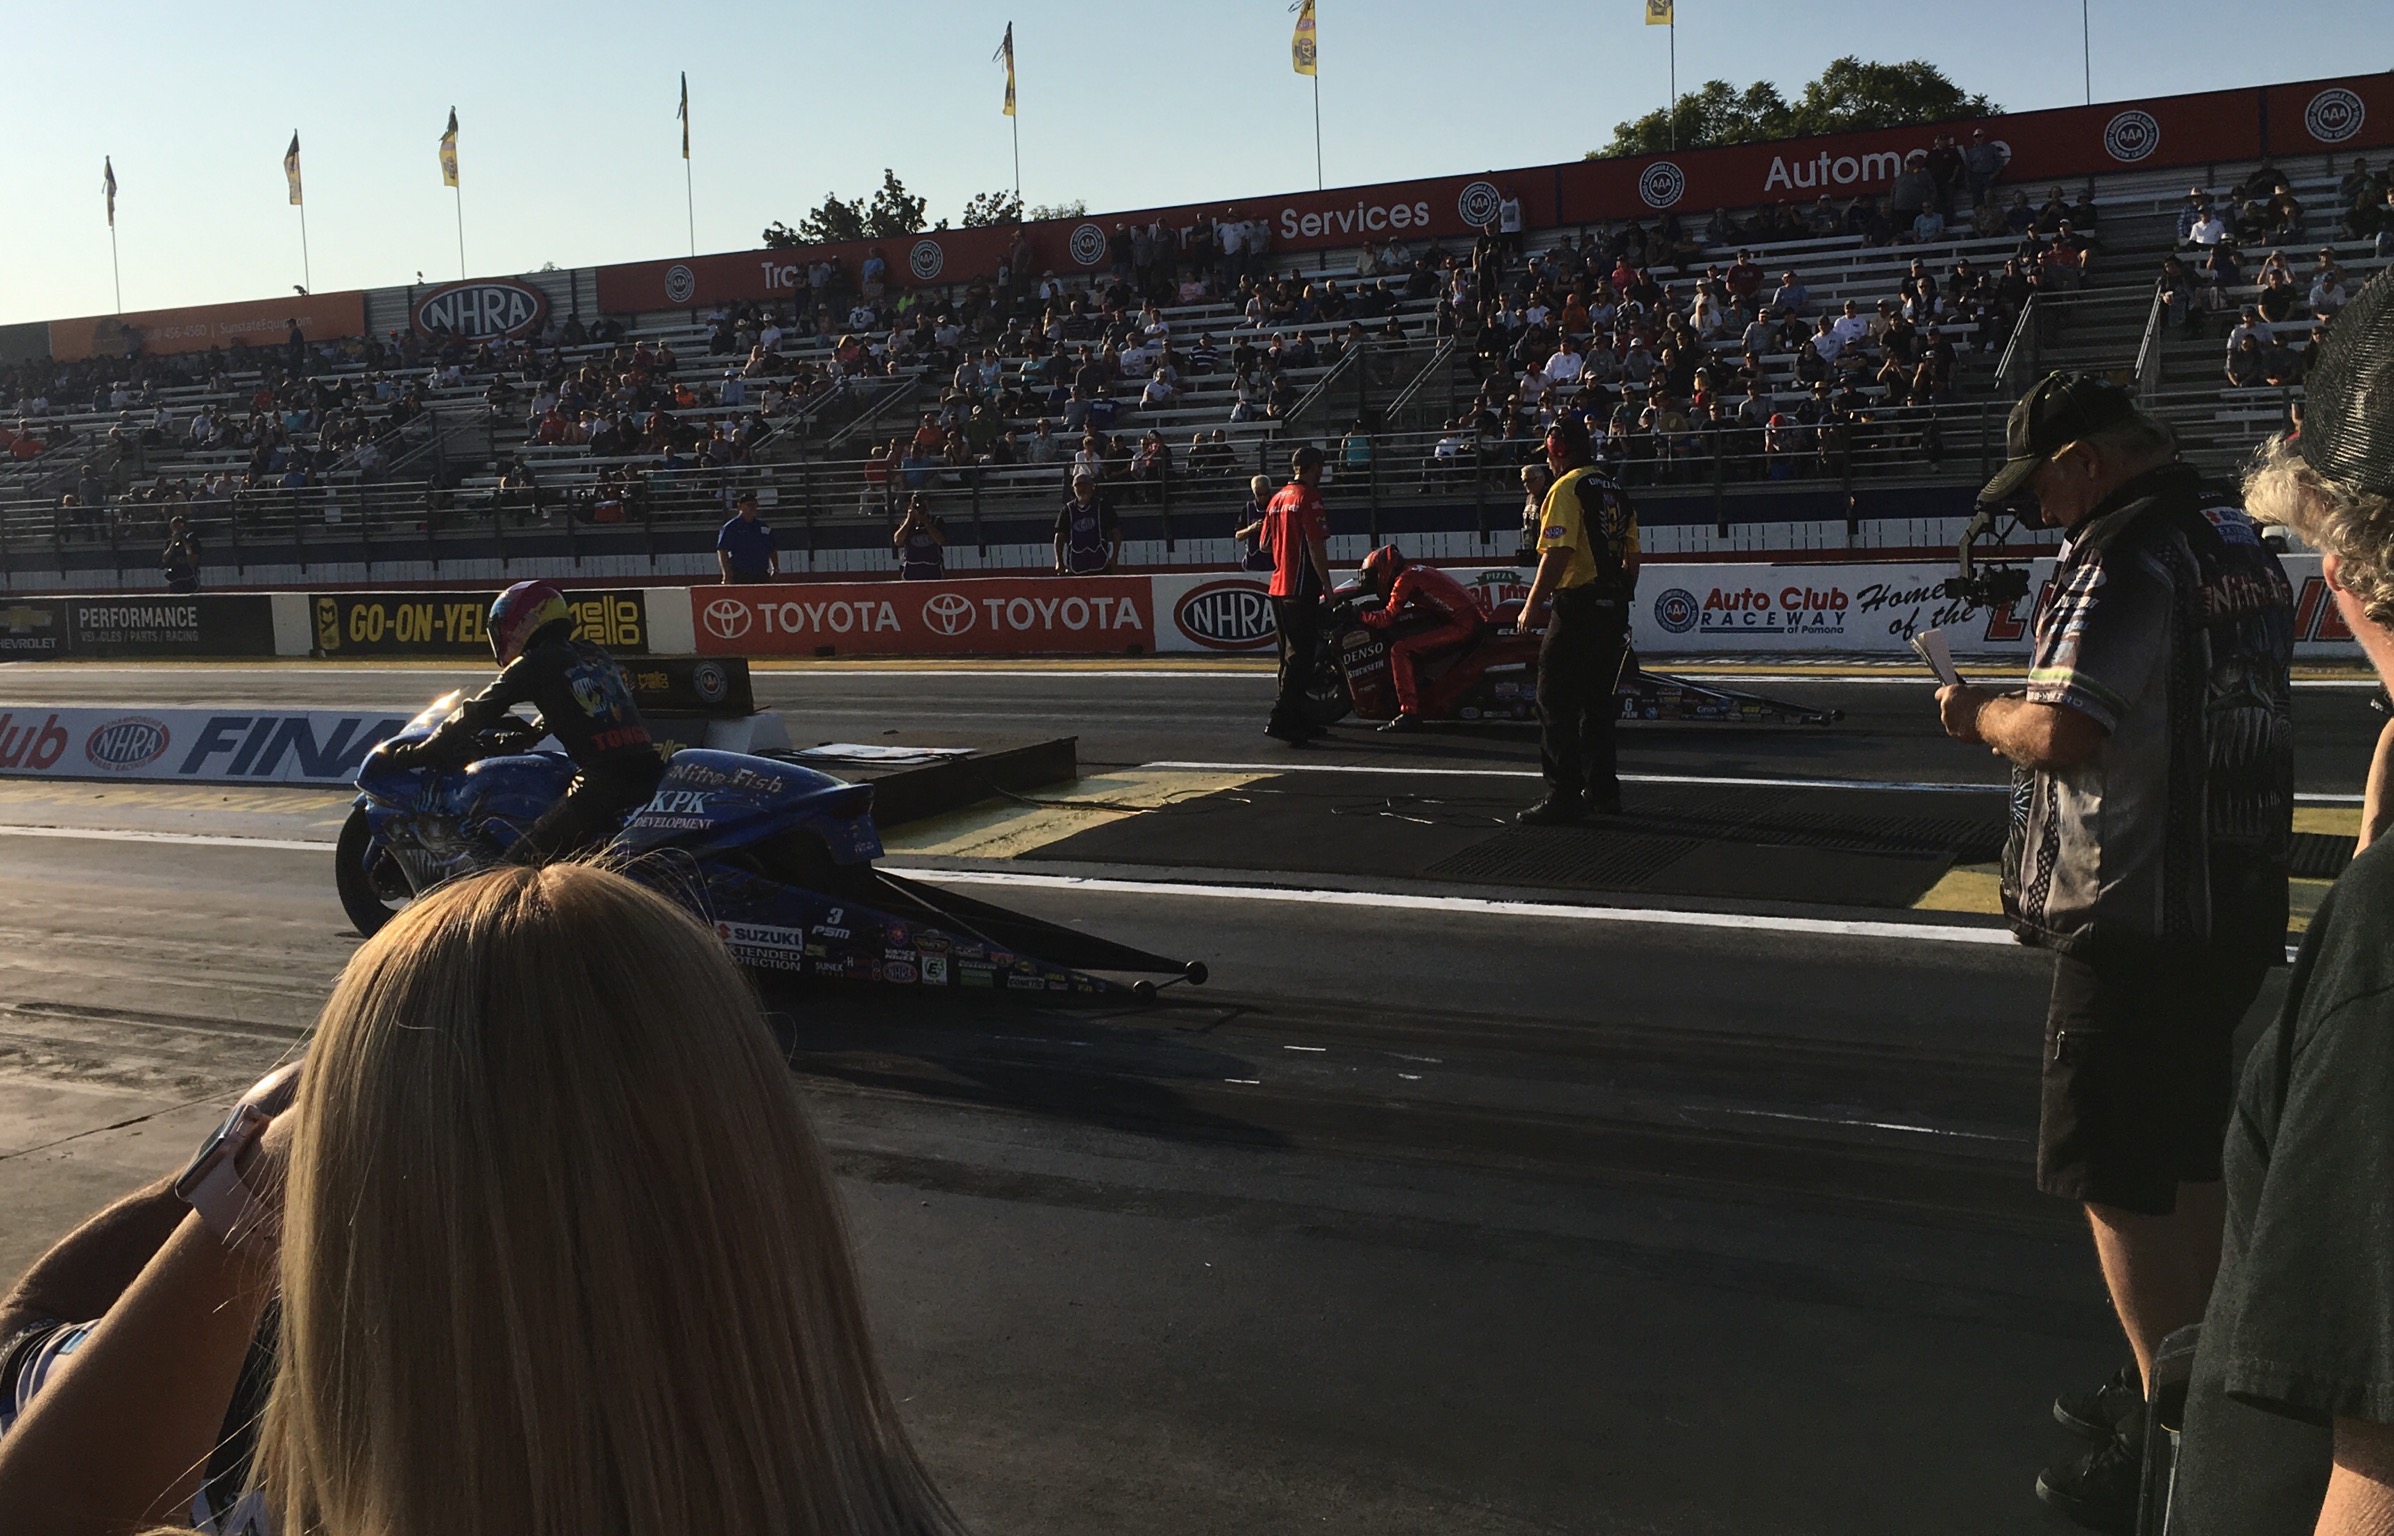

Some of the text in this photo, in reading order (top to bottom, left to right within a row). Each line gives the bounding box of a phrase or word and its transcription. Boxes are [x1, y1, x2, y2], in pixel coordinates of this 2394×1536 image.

[2322, 107, 2347, 121] AAA
[2120, 128, 2143, 141] AAA
[1652, 178, 1671, 190] AAA
[1471, 198, 1488, 209] AAA
[1281, 201, 1430, 239] Services
[1080, 238, 1095, 250] AAA
[918, 252, 934, 266] AAA
[672, 278, 687, 289] AAA
[430, 288, 527, 335] NHRA
[220, 317, 312, 335] SunstateEquipom
[1486, 572, 1513, 580] PIZZA
[1703, 587, 1771, 612] Auto
[1780, 587, 1850, 612] Club
[1856, 582, 1946, 613] Home
[79, 606, 198, 629] PERFORMANCE
[757, 601, 901, 634] TOYOTA
[982, 597, 1142, 631] TOYOTA
[1193, 594, 1277, 637] NHRA
[1667, 604, 1686, 616] AAA
[1701, 611, 1848, 626] RACEWAY
[349, 603, 489, 643] GO-ON-YEL
[1889, 607, 1920, 642] of
[1931, 600, 1977, 630] the
[130, 631, 158, 644] PARTS
[166, 630, 199, 643] RACING
[1786, 626, 1845, 635] at Pomona
[0, 638, 57, 649] HEVROLET
[1343, 642, 1384, 665] DENSO
[1624, 697, 1633, 711] 6
[0, 713, 68, 770] ub
[97, 726, 157, 761] NHRA
[671, 763, 784, 793] Nitro Fish
[645, 790, 717, 815] KPK
[633, 816, 715, 830] DEVELOPMENT
[826, 907, 844, 925] 3
[734, 927, 800, 946] SUZUKI
[728, 945, 801, 961] XTENDED
[735, 955, 801, 972] OTECTION
